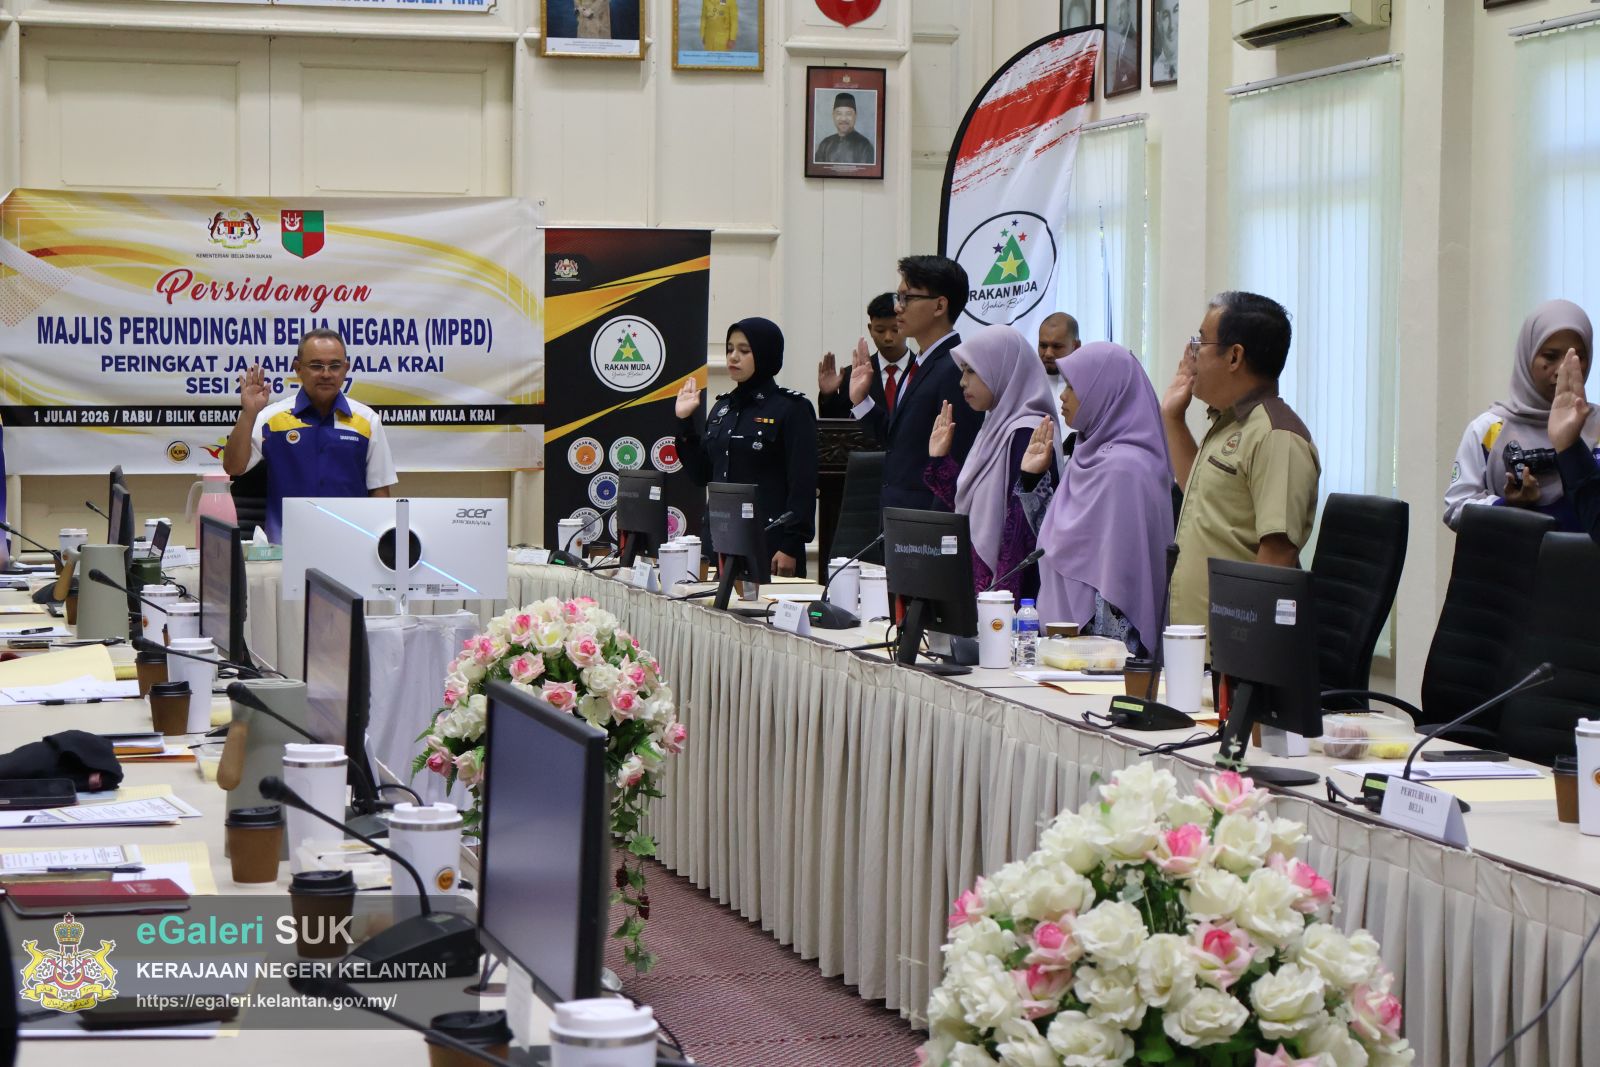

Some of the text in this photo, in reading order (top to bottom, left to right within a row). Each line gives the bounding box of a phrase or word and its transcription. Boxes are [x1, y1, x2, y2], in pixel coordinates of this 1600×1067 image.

[156, 268, 372, 313] Persidangan
[969, 286, 1011, 301] RAKAN
[37, 316, 113, 345] MAJLIS
[119, 317, 267, 345] PERUNDINGAN
[338, 318, 419, 346] NEGARA
[425, 317, 493, 353] (MPBD)
[101, 355, 218, 373] PERINGKAT
[347, 355, 392, 373] ALA
[398, 356, 444, 373] KRAI
[186, 376, 229, 394] SESI
[33, 410, 39, 423] 1
[44, 410, 77, 423] JULAI
[81, 410, 110, 423] 2026
[113, 410, 118, 423] /
[122, 410, 153, 423] RABU
[157, 410, 162, 423] /
[166, 410, 195, 423] BILIK
[430, 409, 466, 422] KUALA
[469, 409, 496, 422] KRAI
[456, 508, 493, 519] acer
[1400, 786, 1437, 803] PERTUBUHAN
[1408, 802, 1424, 815] BELIA
